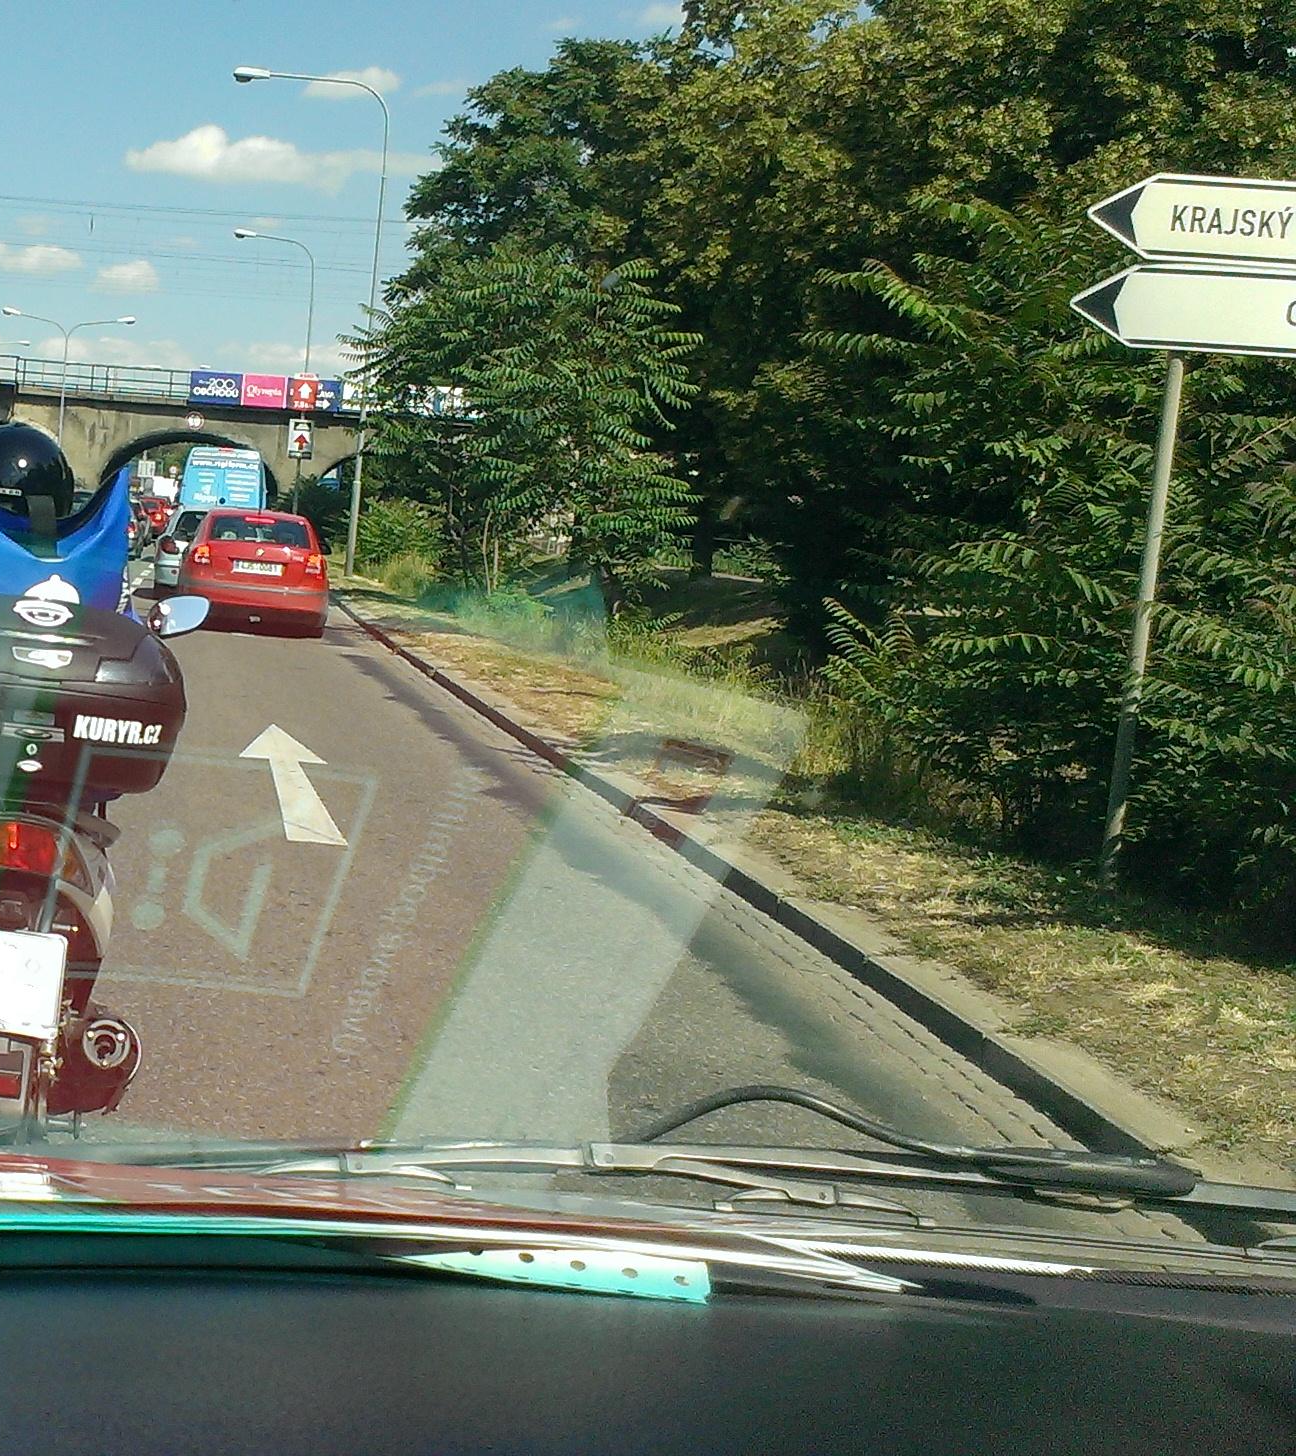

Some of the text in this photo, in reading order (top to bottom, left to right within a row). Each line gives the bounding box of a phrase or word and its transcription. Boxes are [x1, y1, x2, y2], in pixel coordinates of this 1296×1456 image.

[1170, 205, 1294, 239] KRAJSKÝ
[209, 378, 236, 390] 200
[246, 384, 282, 397] Olympia
